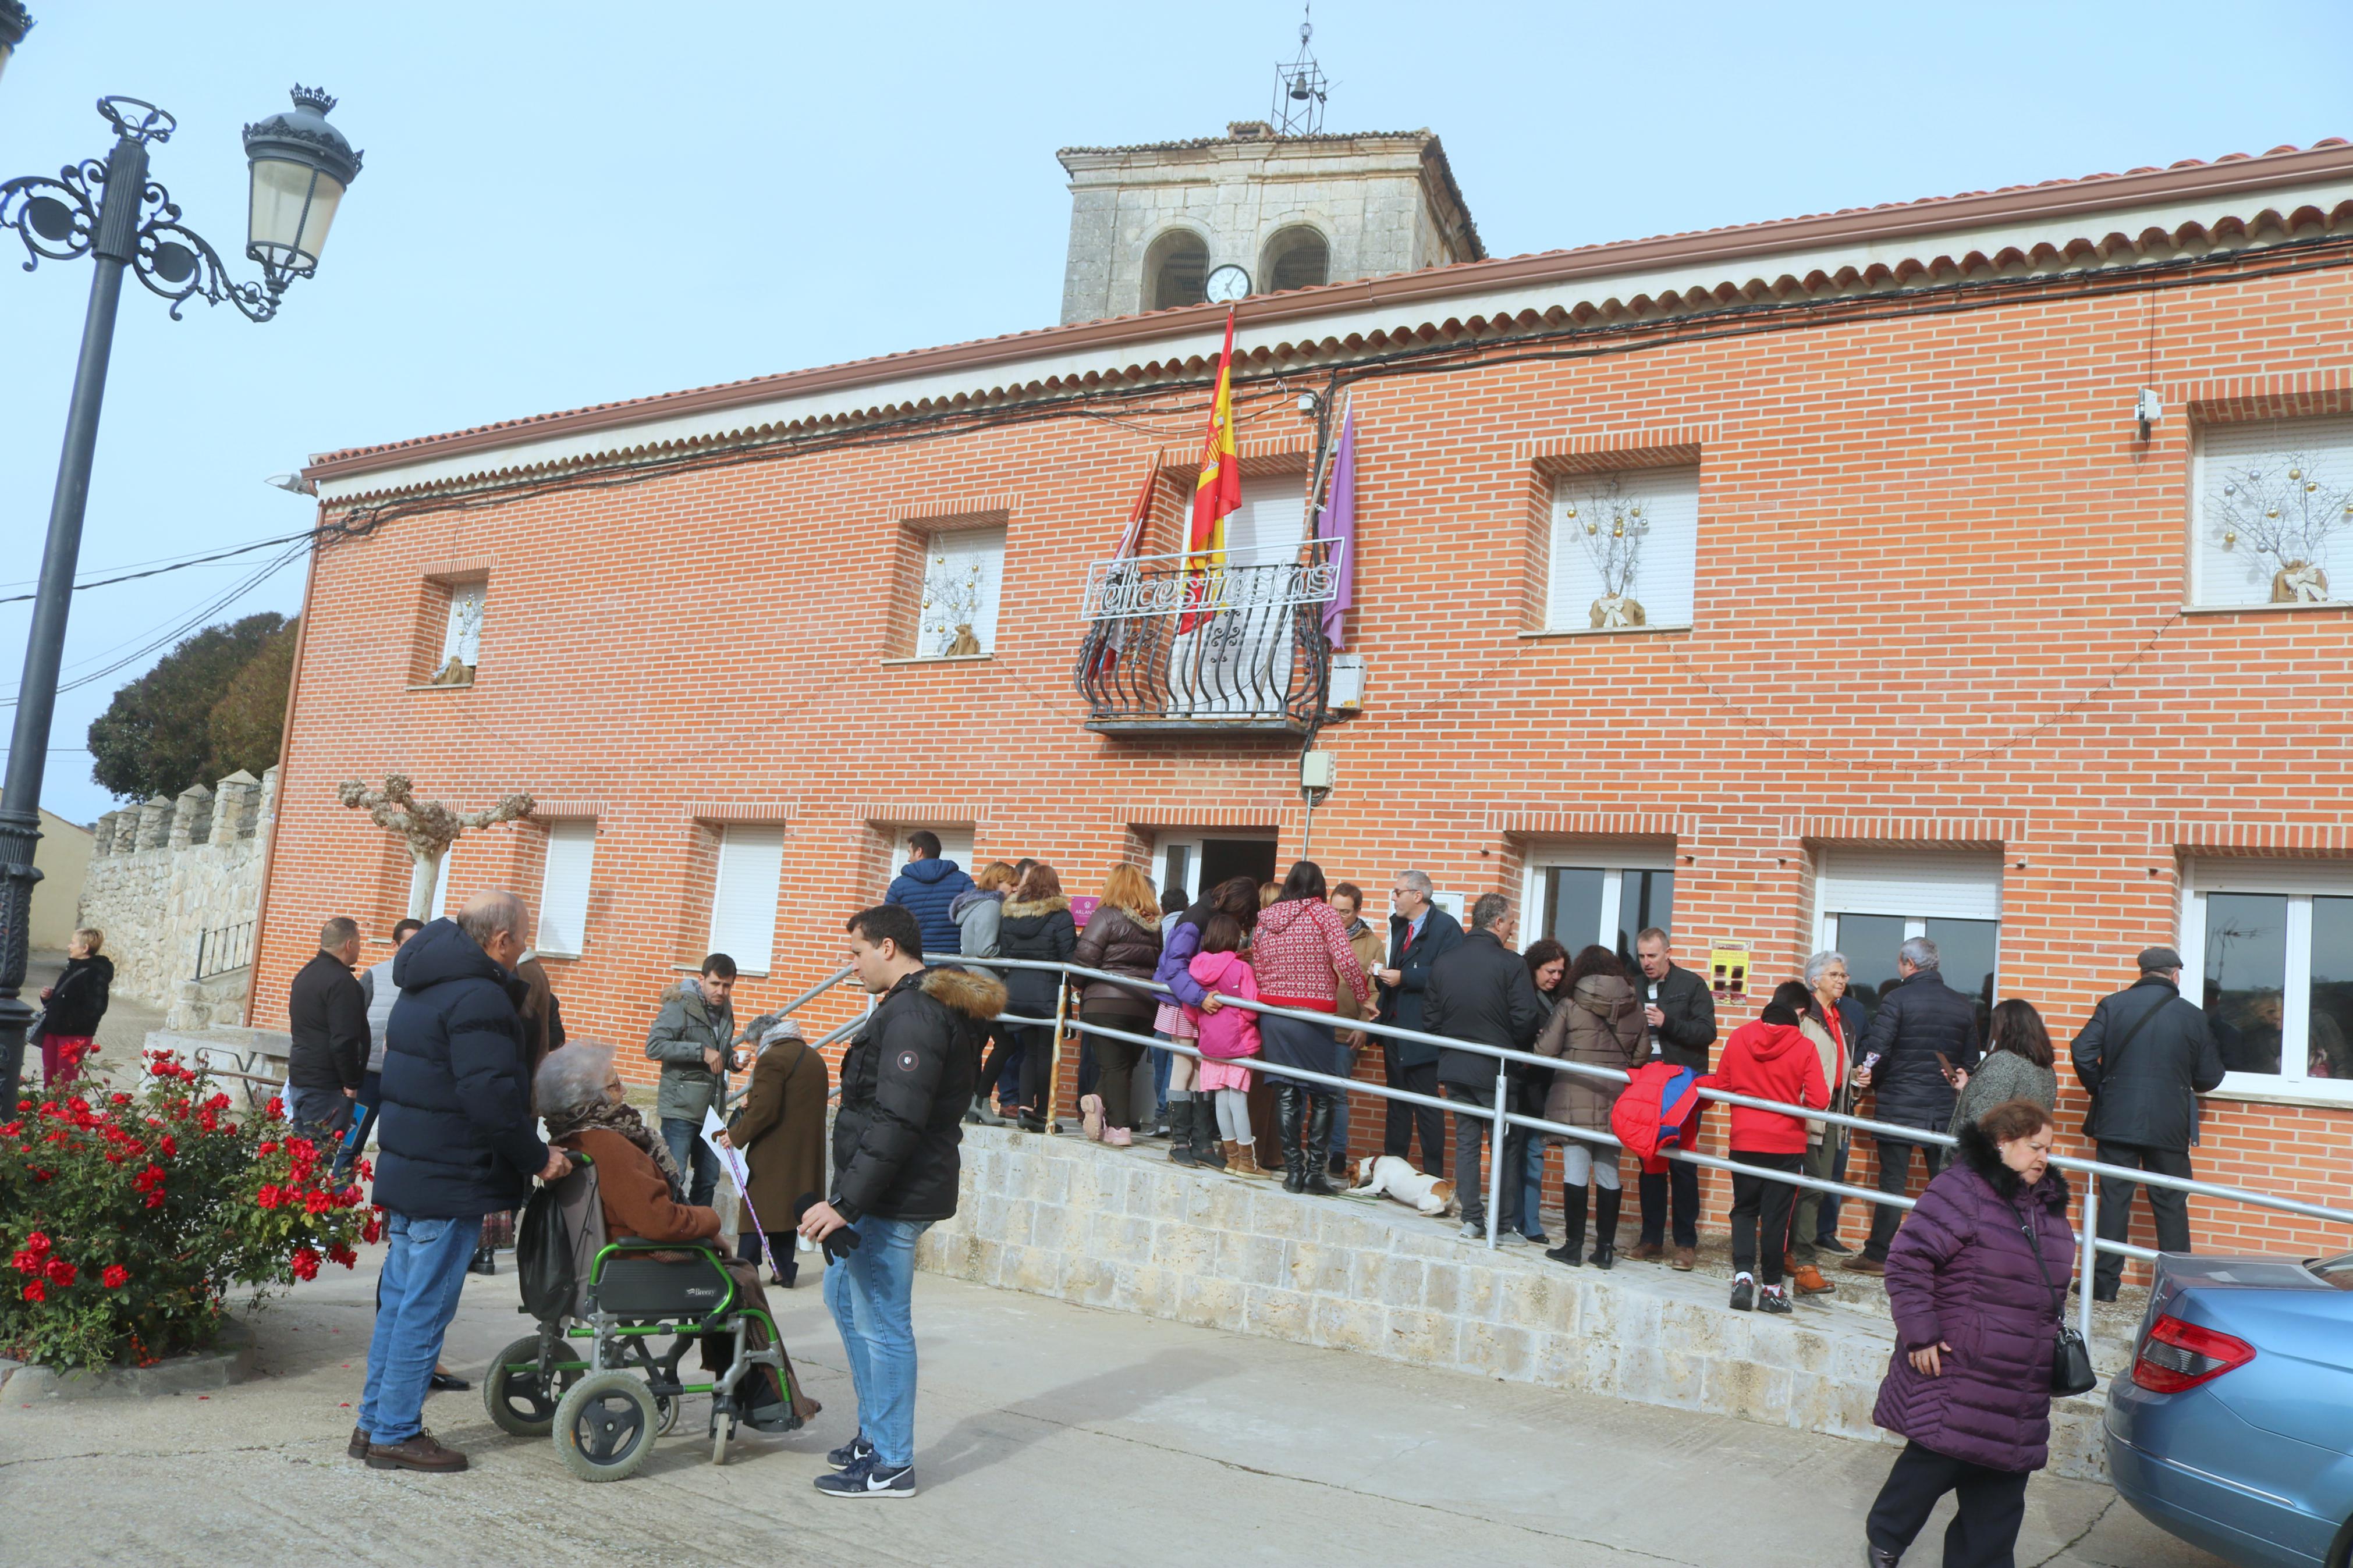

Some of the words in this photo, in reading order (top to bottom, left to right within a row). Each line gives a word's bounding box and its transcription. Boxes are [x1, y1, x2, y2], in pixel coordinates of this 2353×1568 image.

[1084, 562, 1206, 617] Felices
[1200, 559, 1337, 607] Fiestas
[695, 1288, 716, 1296] Breezy
